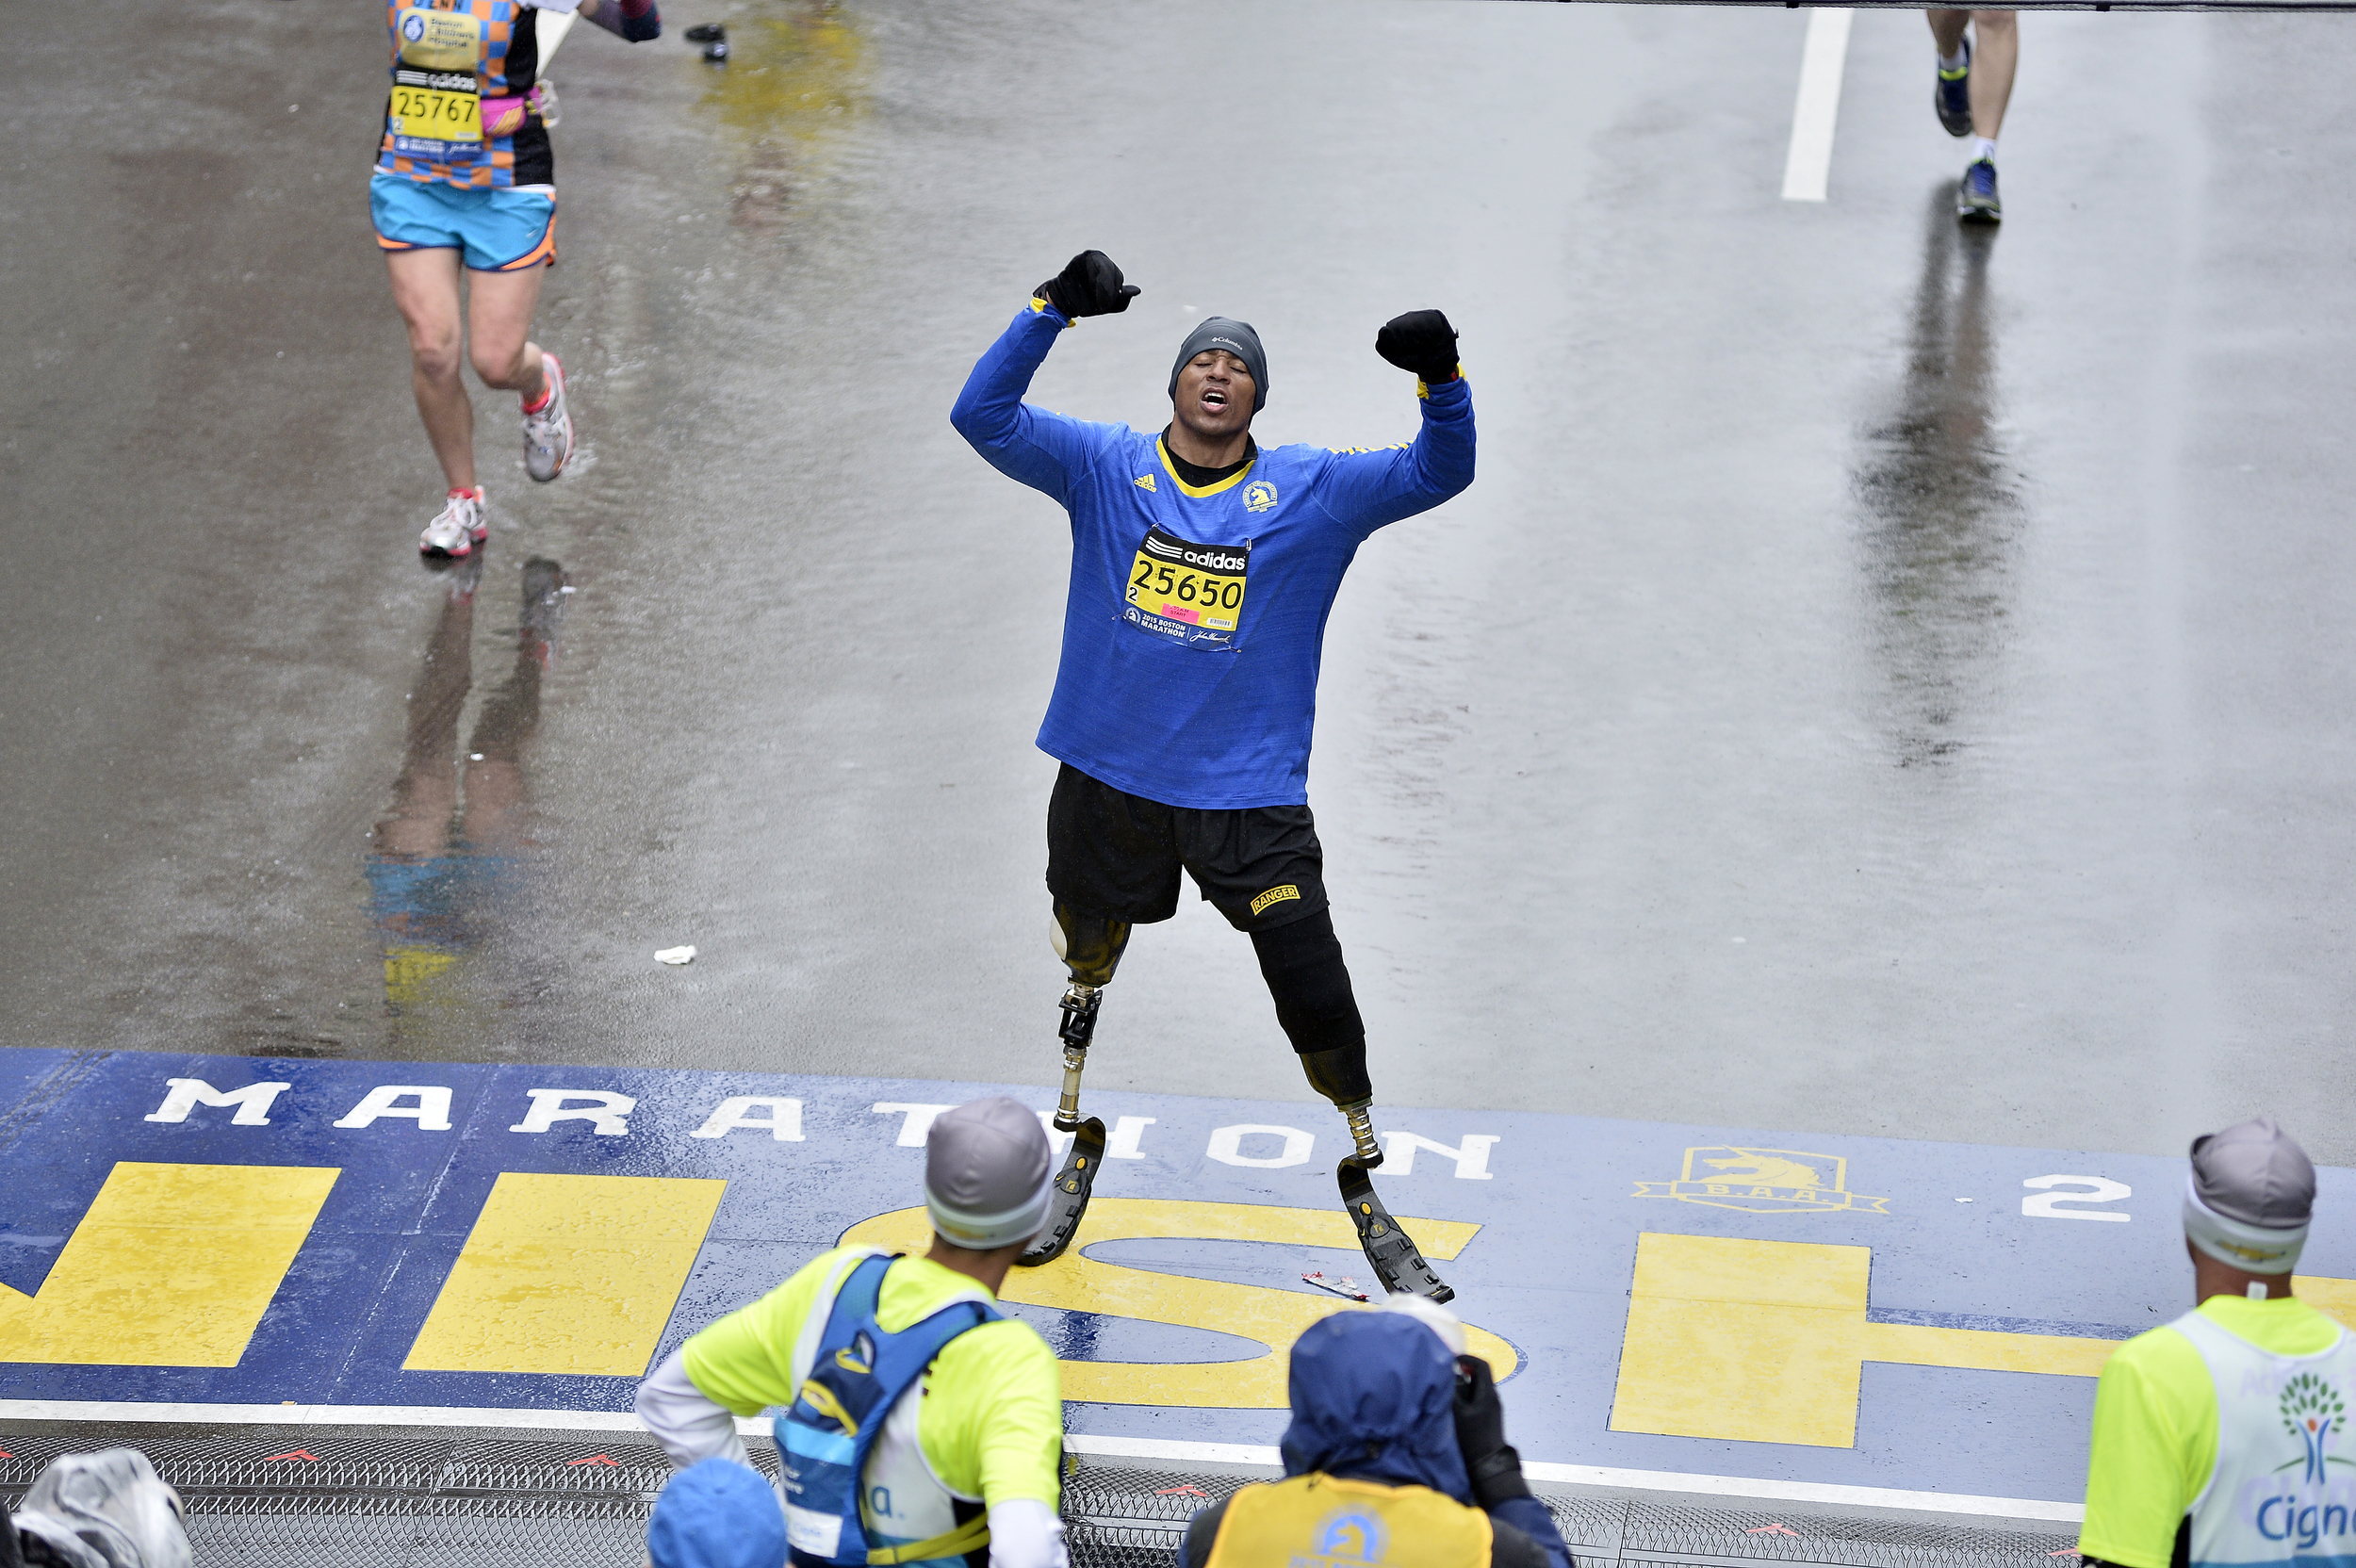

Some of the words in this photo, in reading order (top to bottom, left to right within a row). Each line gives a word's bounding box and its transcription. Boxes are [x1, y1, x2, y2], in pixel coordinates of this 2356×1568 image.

[399, 92, 475, 122] 25767
[1185, 550, 1245, 570] adidas
[1128, 586, 1138, 601] 2
[1133, 560, 1242, 610] 25650
[1140, 620, 1186, 638] MARATHON
[1142, 613, 1157, 624] 2015
[1158, 619, 1186, 631] BOSTON
[1253, 888, 1297, 910] RANGER
[1706, 1184, 1830, 1202] B.A.A.
[2256, 1494, 2356, 1549] Cign
